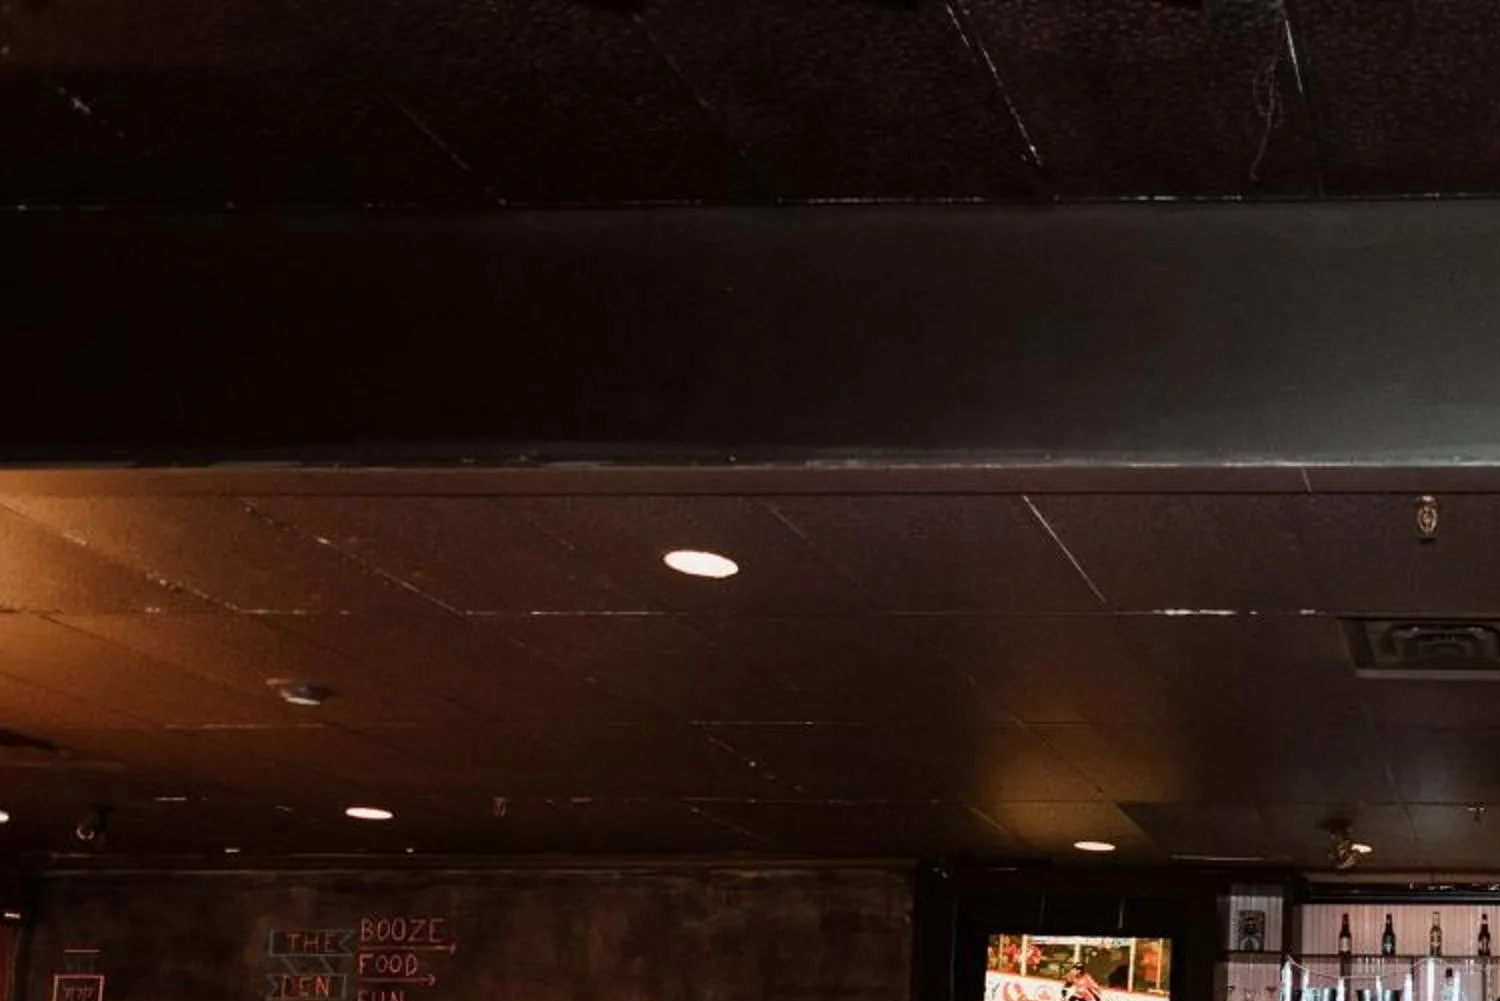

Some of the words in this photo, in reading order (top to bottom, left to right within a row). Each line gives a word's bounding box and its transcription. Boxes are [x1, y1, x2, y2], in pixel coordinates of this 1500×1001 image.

[360, 917, 444, 944] BOOZE
[284, 933, 337, 953] THE
[358, 953, 419, 977] FOOD
[281, 975, 332, 999] DEN
